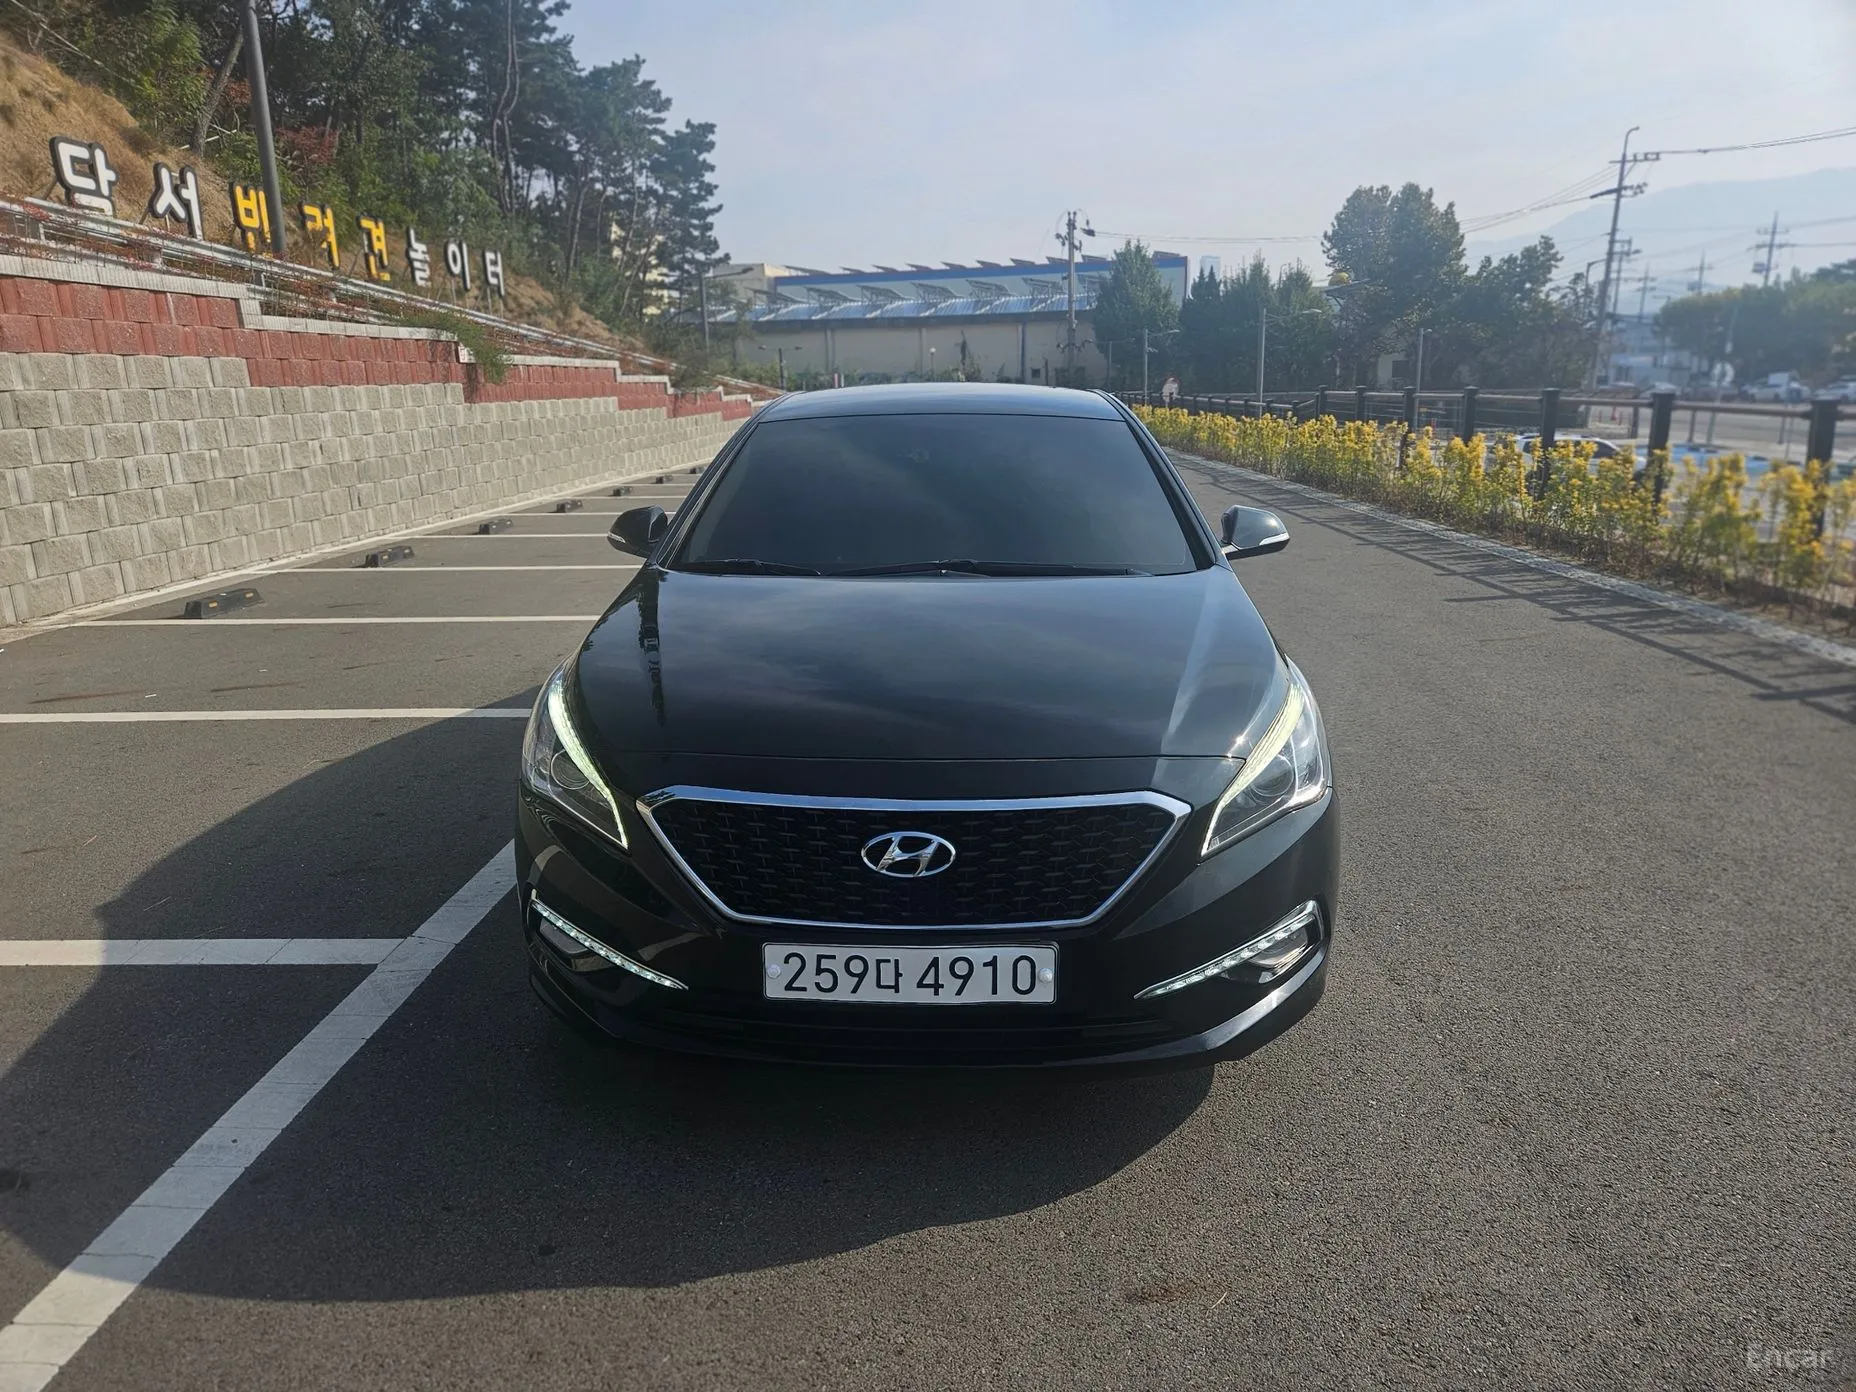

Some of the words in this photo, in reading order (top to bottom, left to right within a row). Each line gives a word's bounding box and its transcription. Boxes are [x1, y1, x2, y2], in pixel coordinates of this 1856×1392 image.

[408, 227, 505, 297] 놀이터
[783, 952, 903, 994] 259다
[916, 954, 1036, 996] 4910
